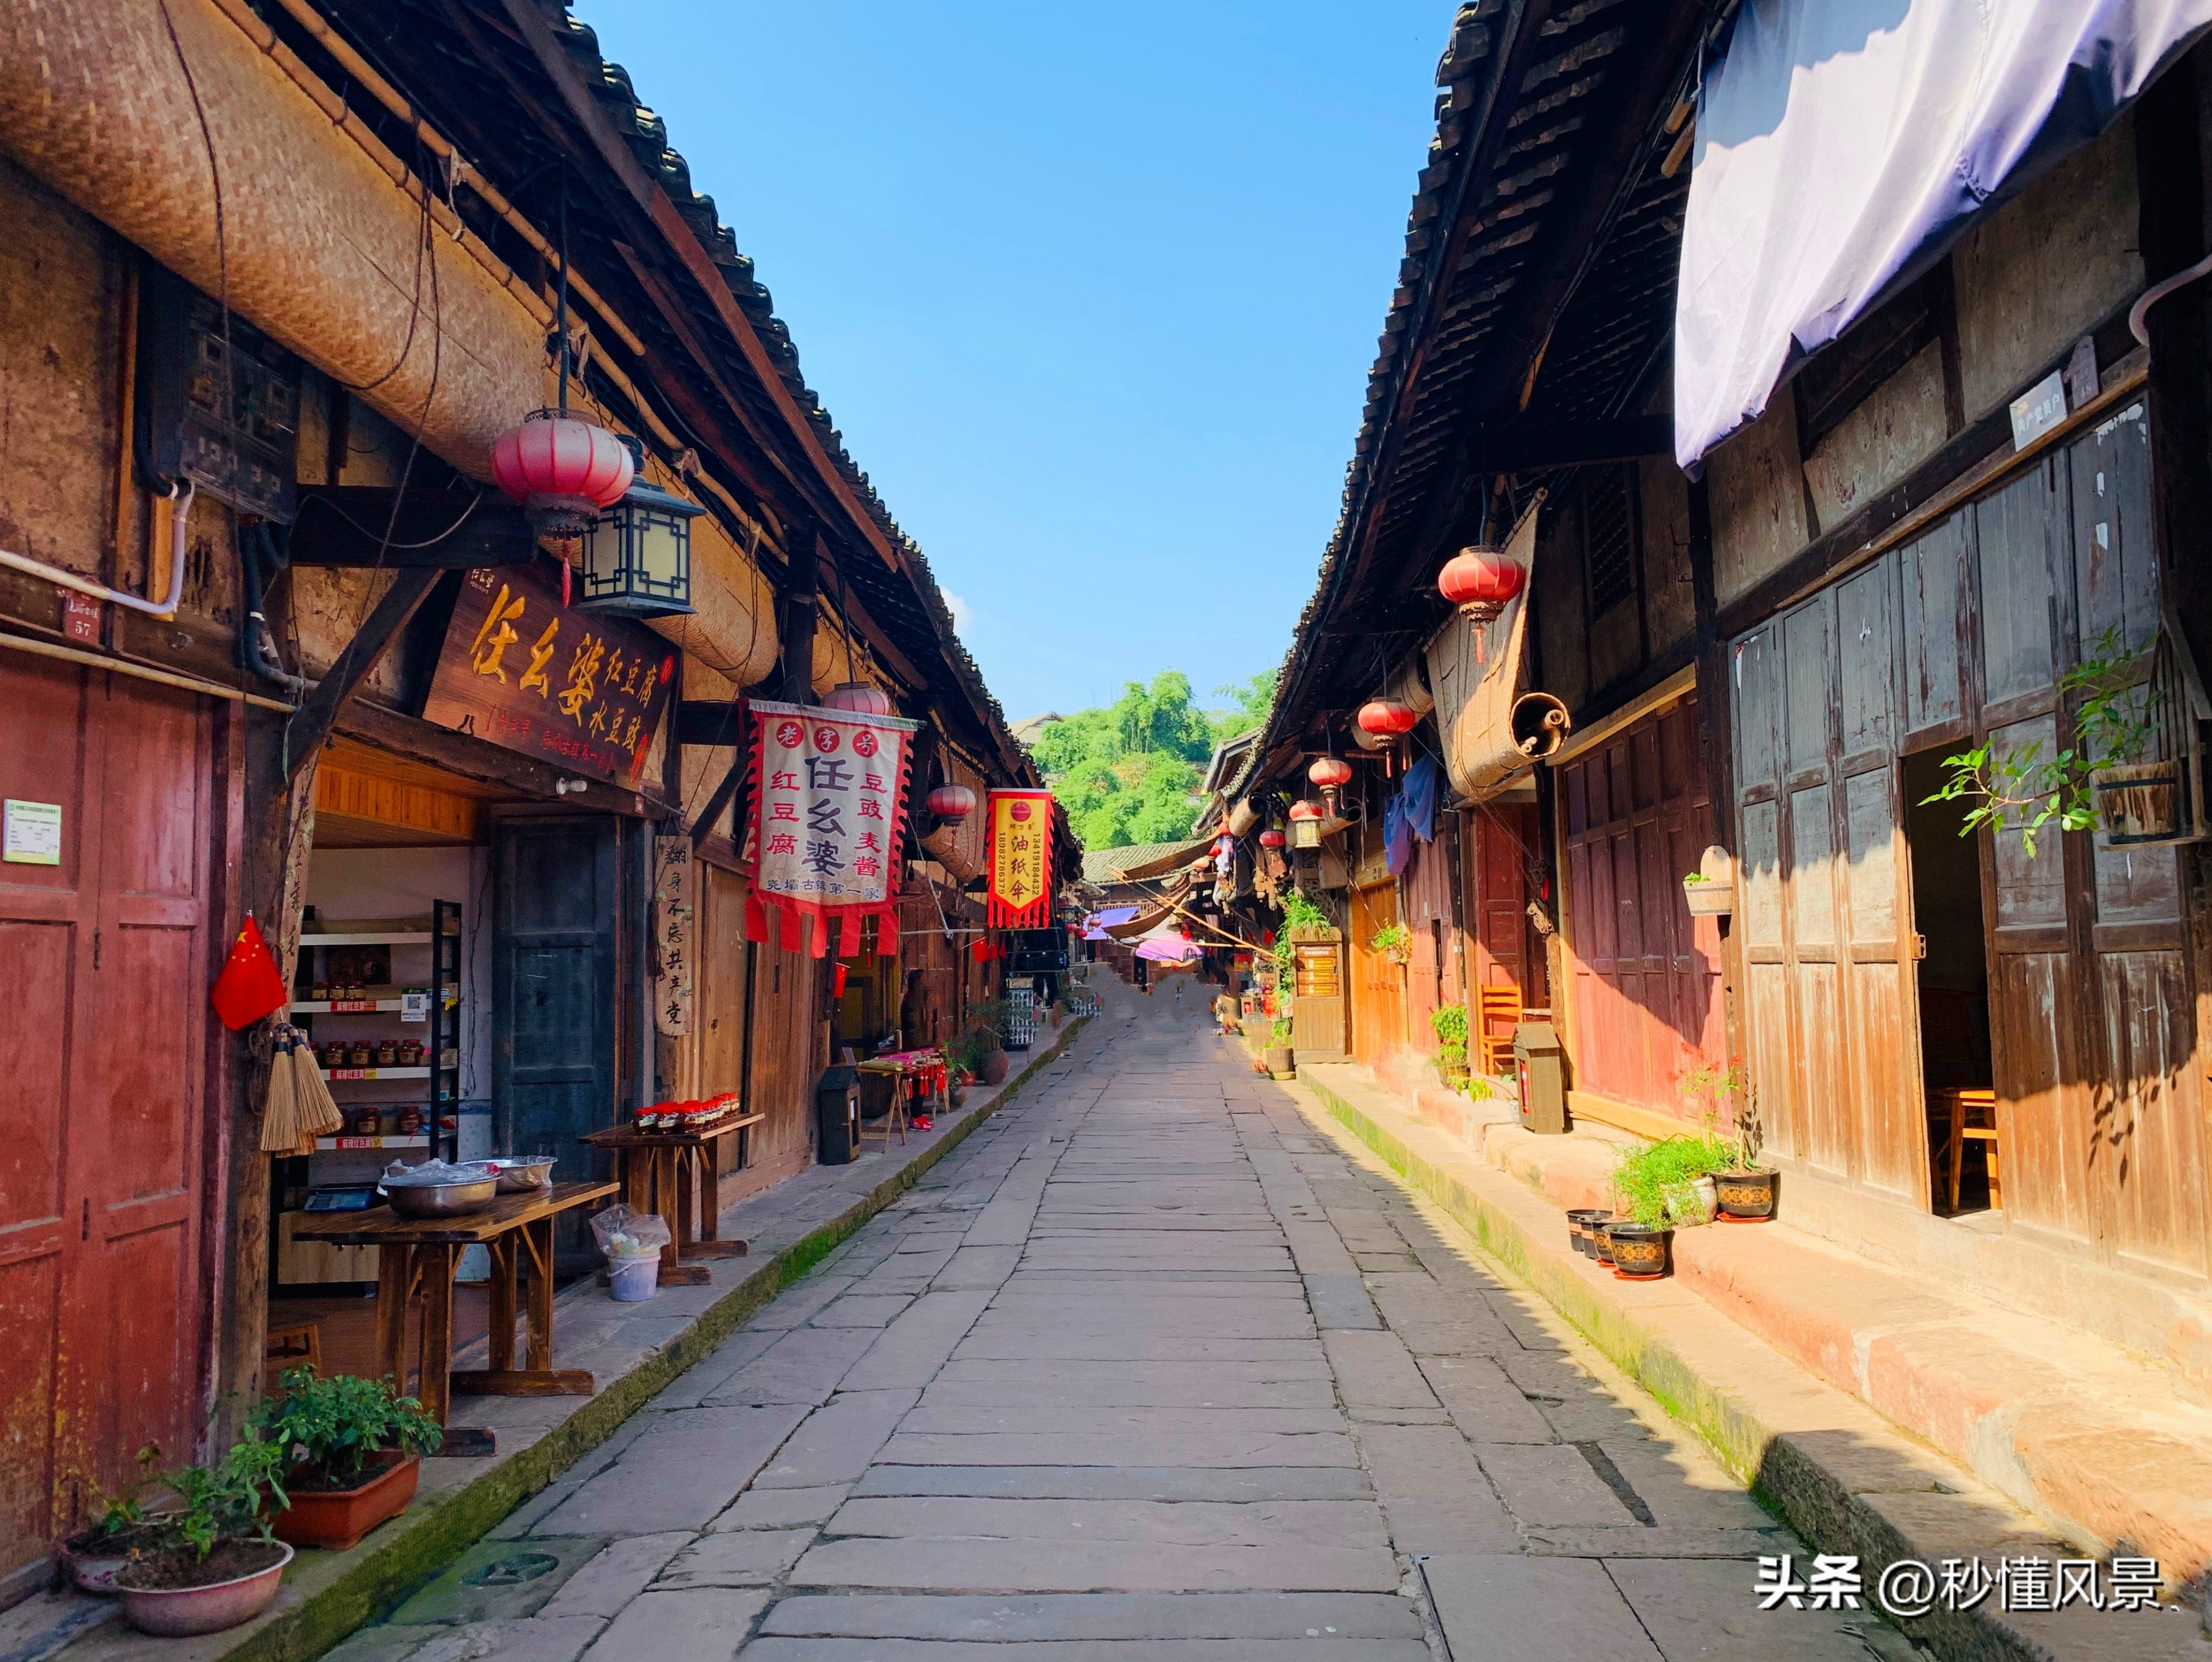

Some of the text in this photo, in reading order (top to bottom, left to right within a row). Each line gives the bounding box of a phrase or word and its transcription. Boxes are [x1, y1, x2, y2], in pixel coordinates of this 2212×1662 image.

[2018, 393, 2061, 435] 共产党员户
[75, 620, 91, 637] 57
[778, 726, 874, 756] 老字号
[766, 769, 801, 855] 红豆腐
[852, 772, 887, 878] 豆豉麦酱
[1009, 835, 1030, 902] 油纸伞
[1032, 833, 1041, 896] 13419184432
[664, 845, 687, 1025] 翻身不忘共产党
